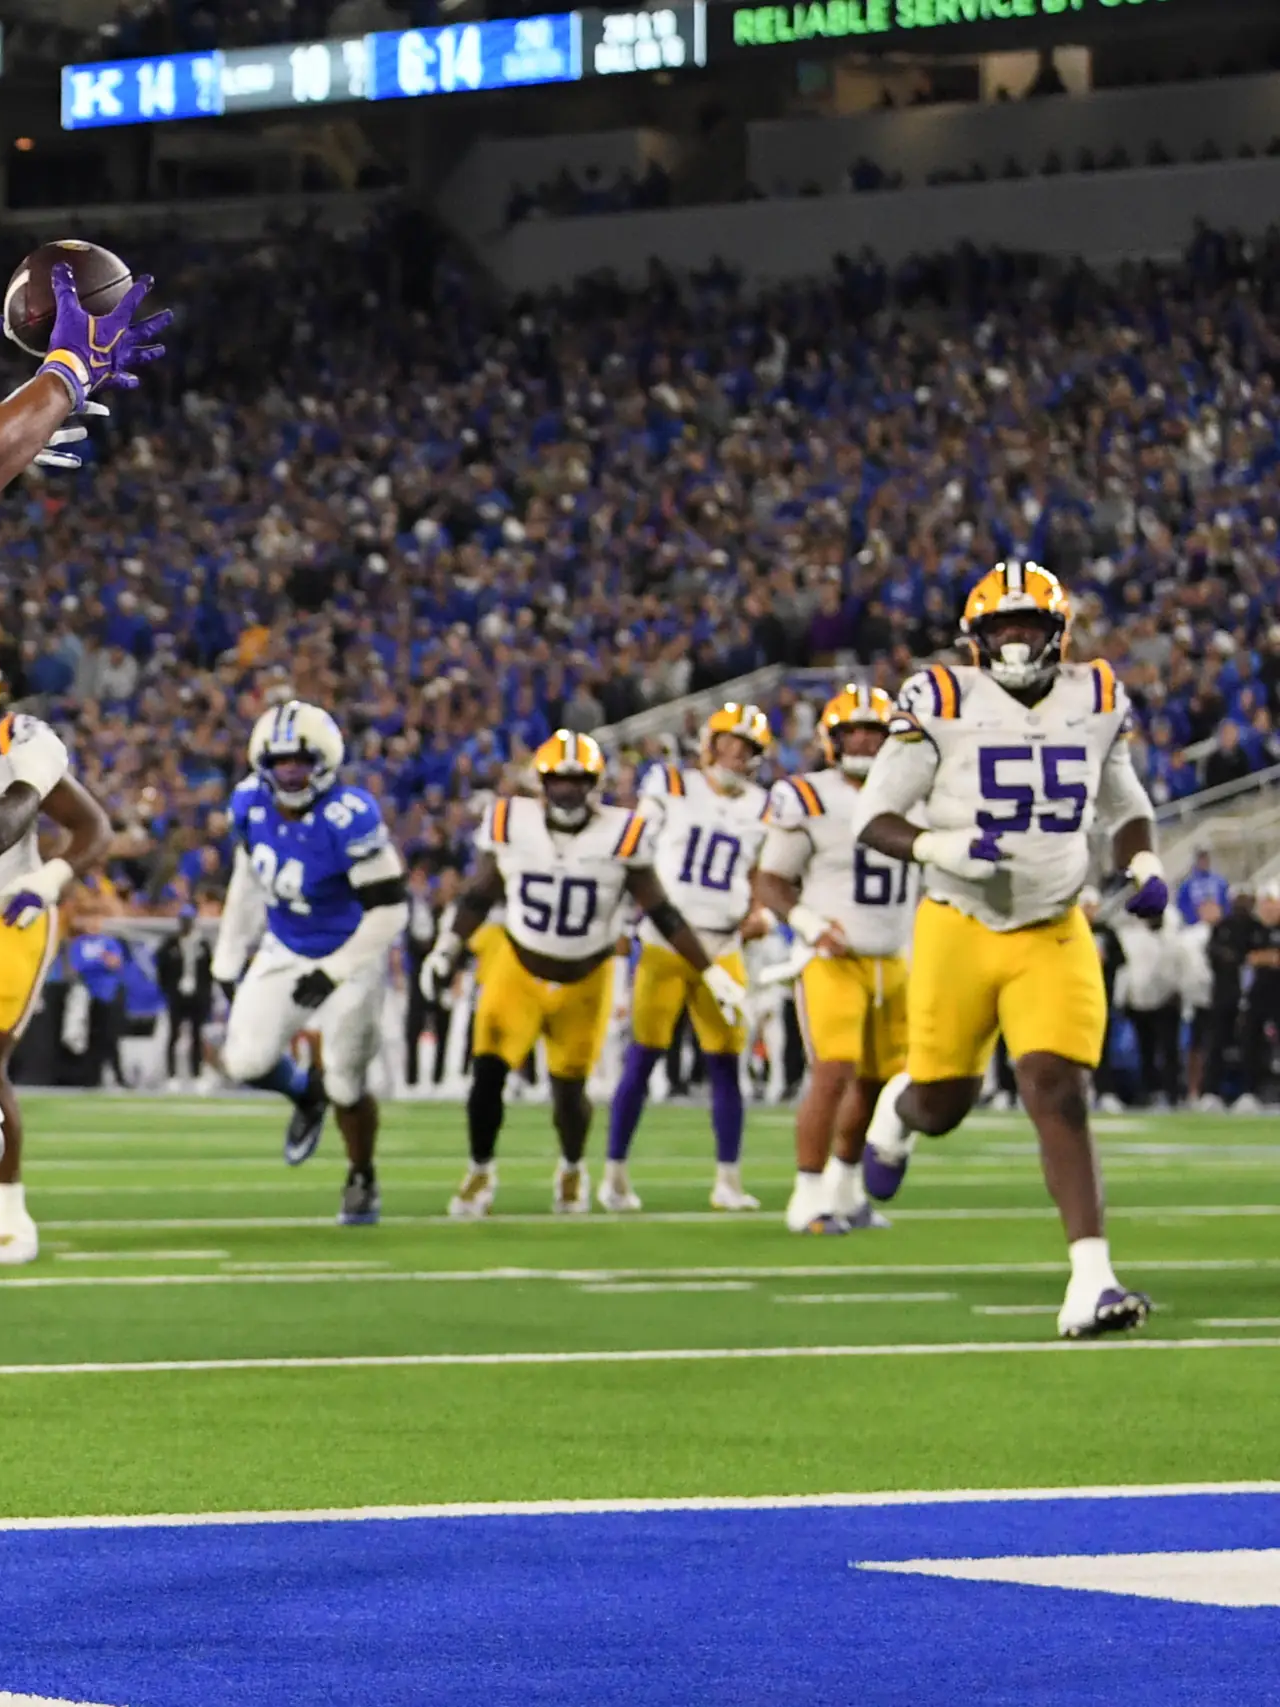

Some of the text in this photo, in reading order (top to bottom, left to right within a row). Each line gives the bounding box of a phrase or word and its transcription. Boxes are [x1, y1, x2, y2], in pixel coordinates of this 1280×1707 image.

[733, 1, 889, 46] RELIABLE
[137, 60, 176, 116] 14
[398, 24, 482, 95] 6:14
[976, 745, 1088, 833] 55
[251, 842, 312, 917] 94
[679, 826, 741, 890] 10
[520, 872, 597, 937] 50
